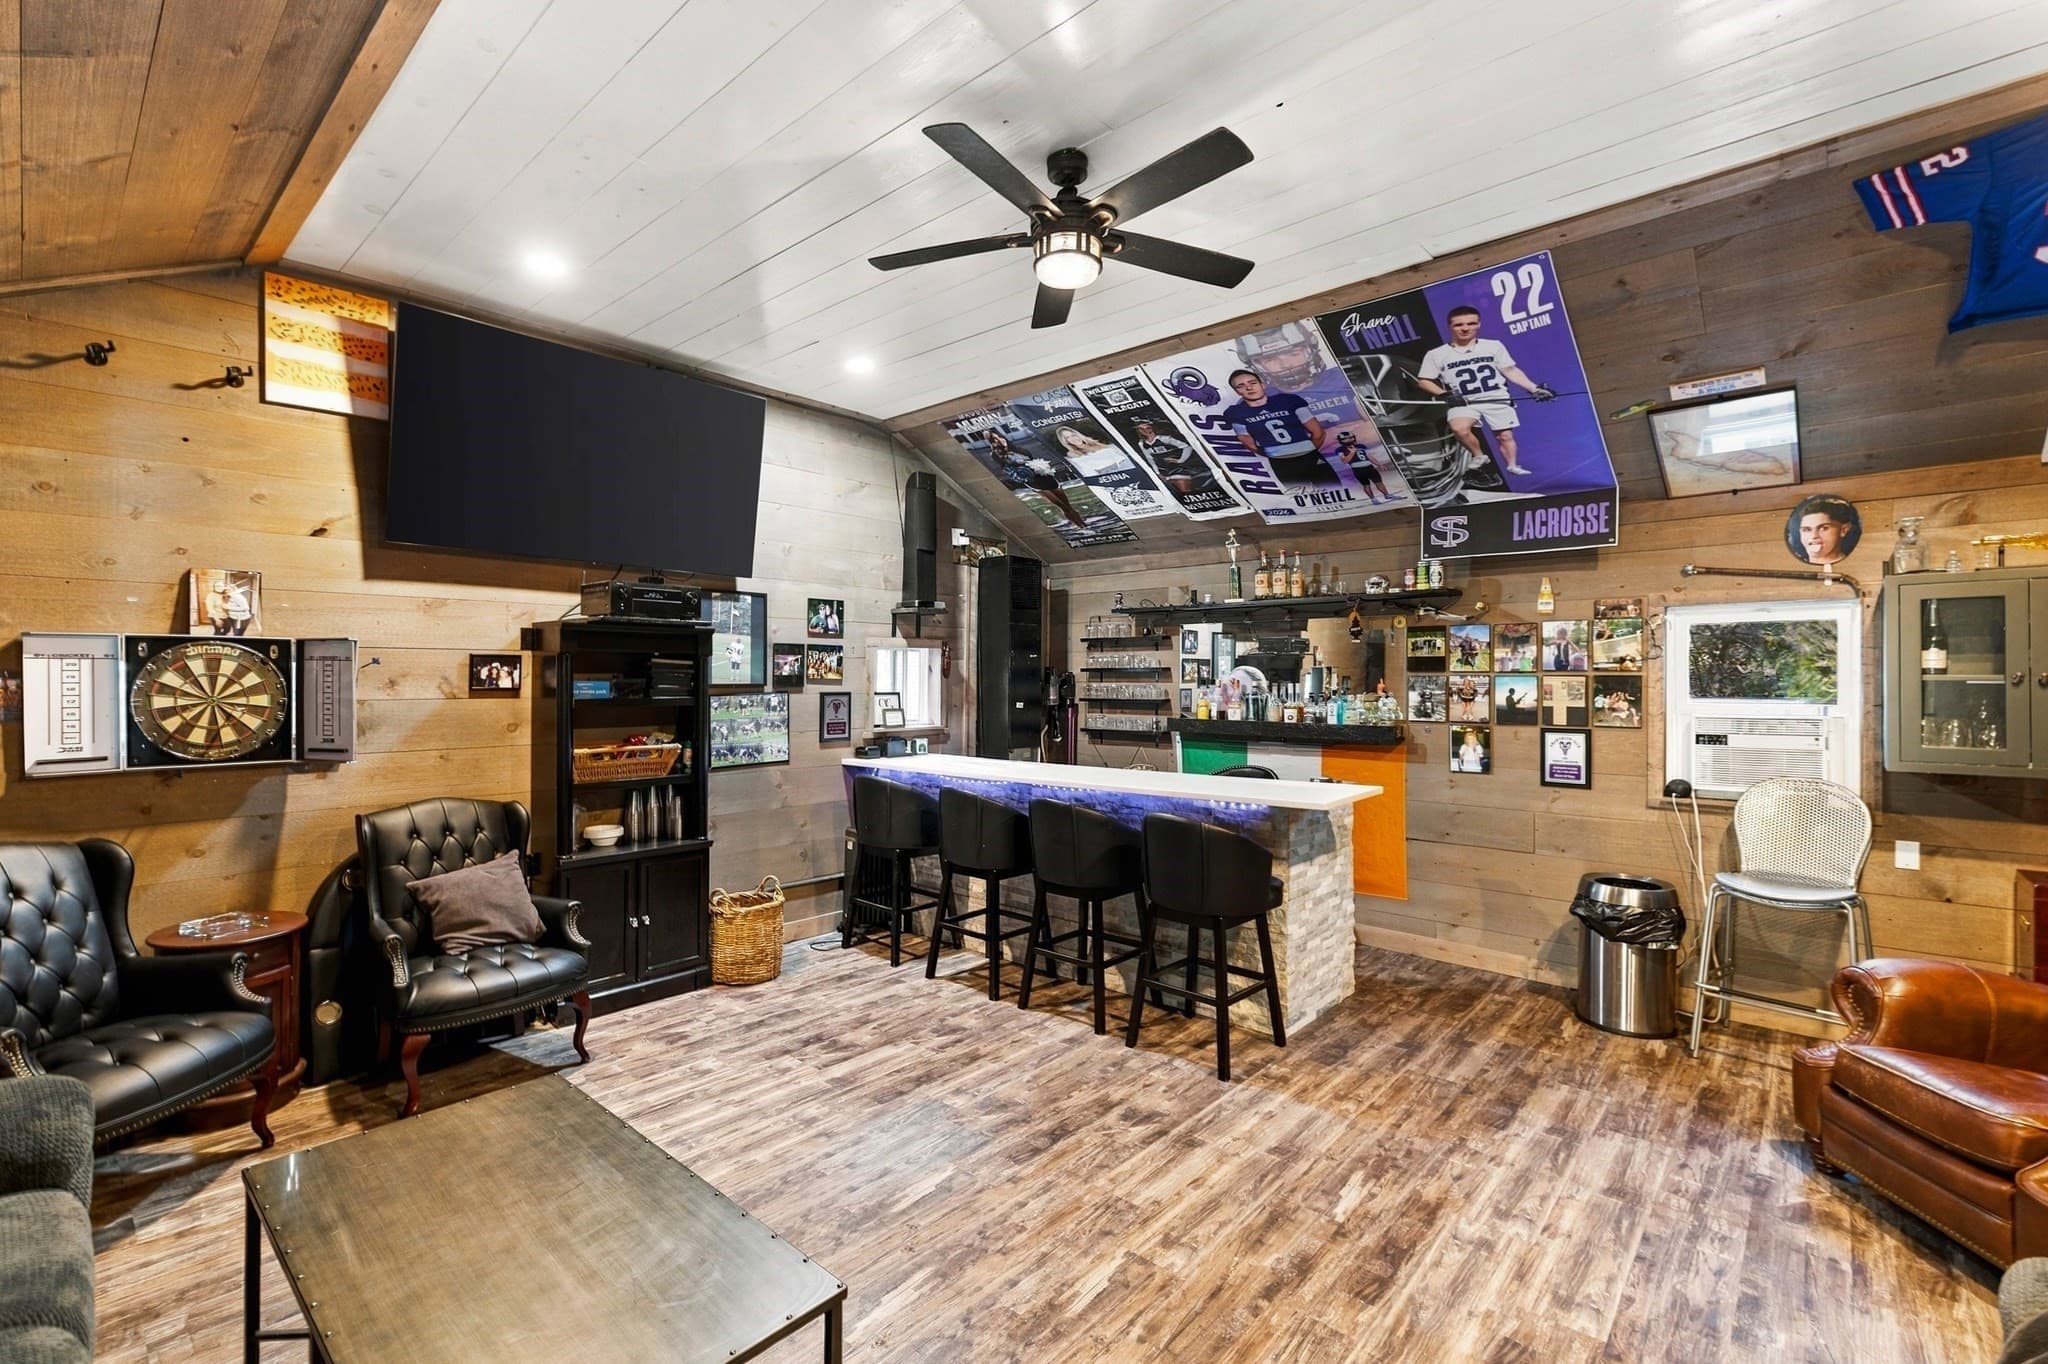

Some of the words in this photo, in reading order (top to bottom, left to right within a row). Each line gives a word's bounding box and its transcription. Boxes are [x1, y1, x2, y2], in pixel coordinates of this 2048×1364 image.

[1491, 263, 1555, 324] 22
[1340, 312, 1396, 337] Shane
[1509, 313, 1552, 335] CAPTAIN
[1455, 364, 1502, 396] 22
[1032, 387, 1071, 405] CLASS
[1103, 399, 1151, 415] WILDCATS
[1031, 411, 1083, 429] CONGRATS!
[1264, 419, 1293, 444] 6
[1188, 413, 1285, 496] RAMS
[1098, 473, 1131, 484] JENNA
[1183, 491, 1224, 503] JAMIE
[1293, 487, 1356, 508] O'NEILL
[1512, 502, 1611, 542] LACROSSE
